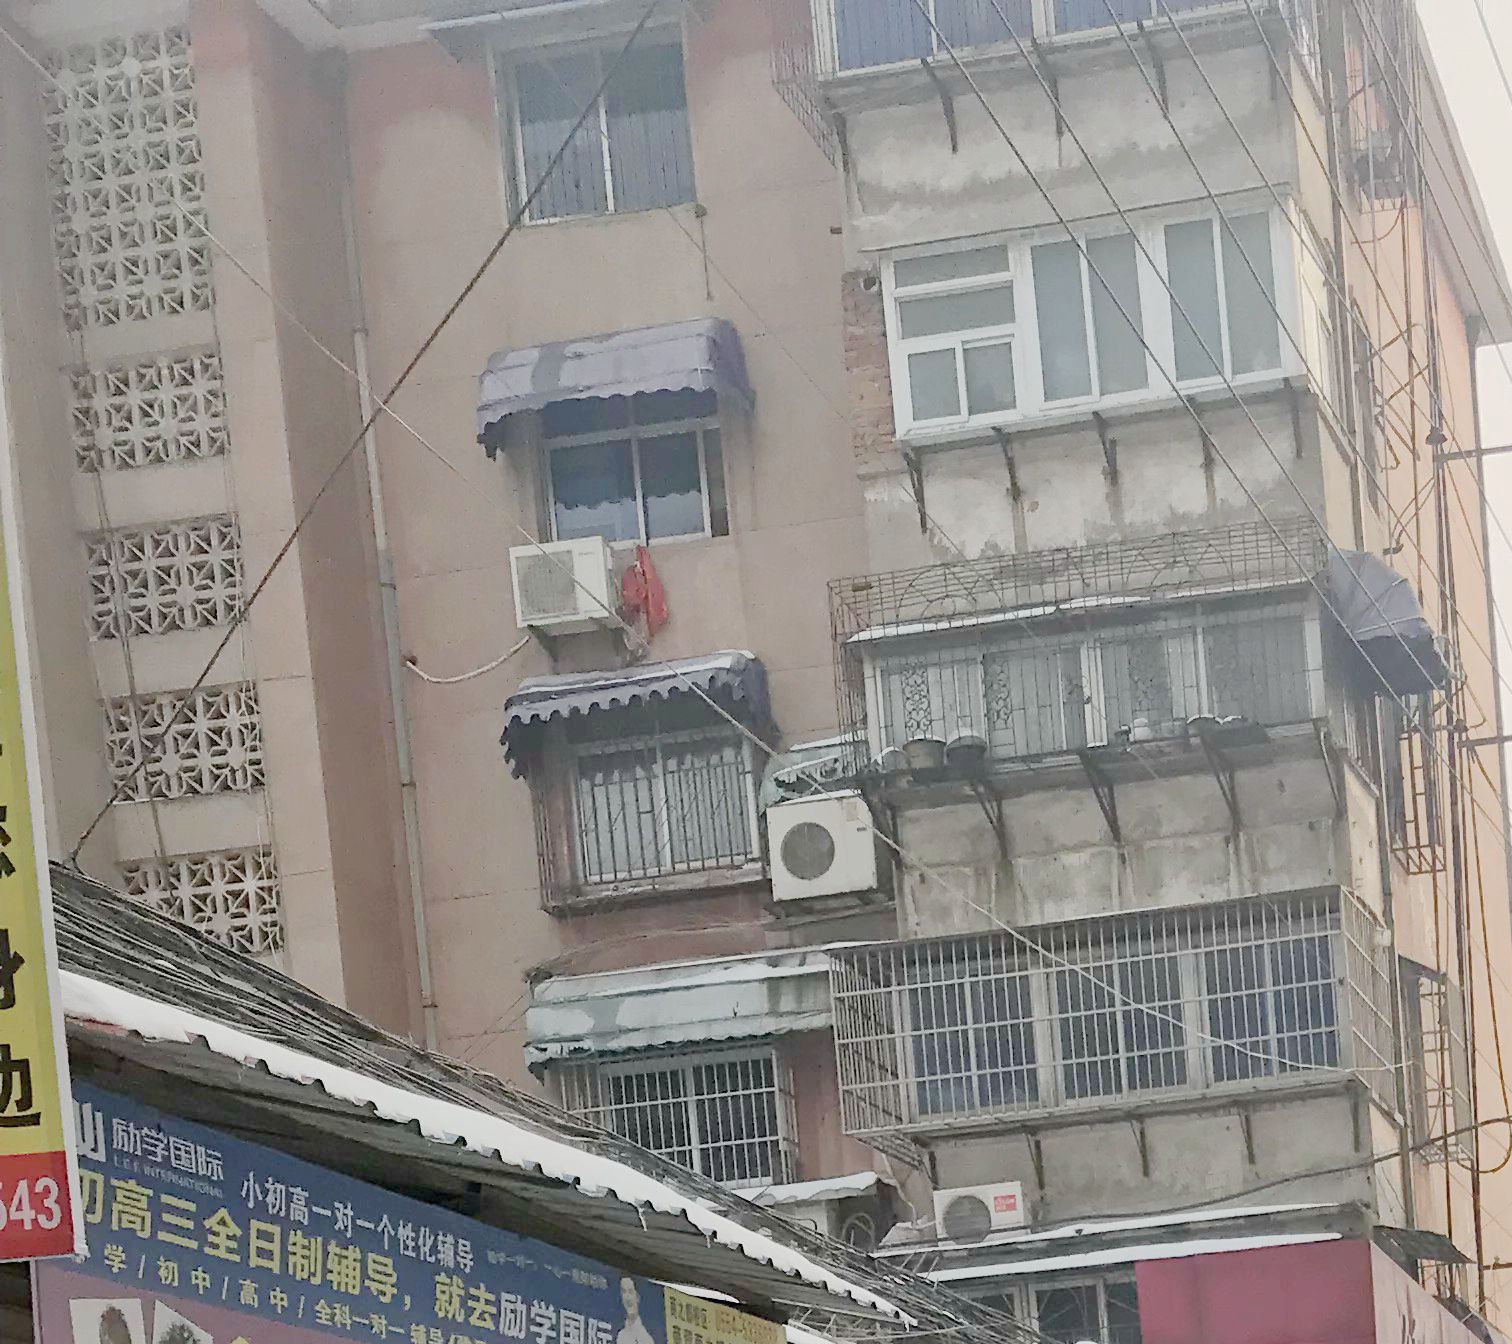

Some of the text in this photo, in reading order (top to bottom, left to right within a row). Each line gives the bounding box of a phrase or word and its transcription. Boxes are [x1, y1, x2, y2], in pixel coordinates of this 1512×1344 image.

[112, 1118, 223, 1181] 励学国际
[241, 1170, 475, 1273] 小初高一对一个性化辅导
